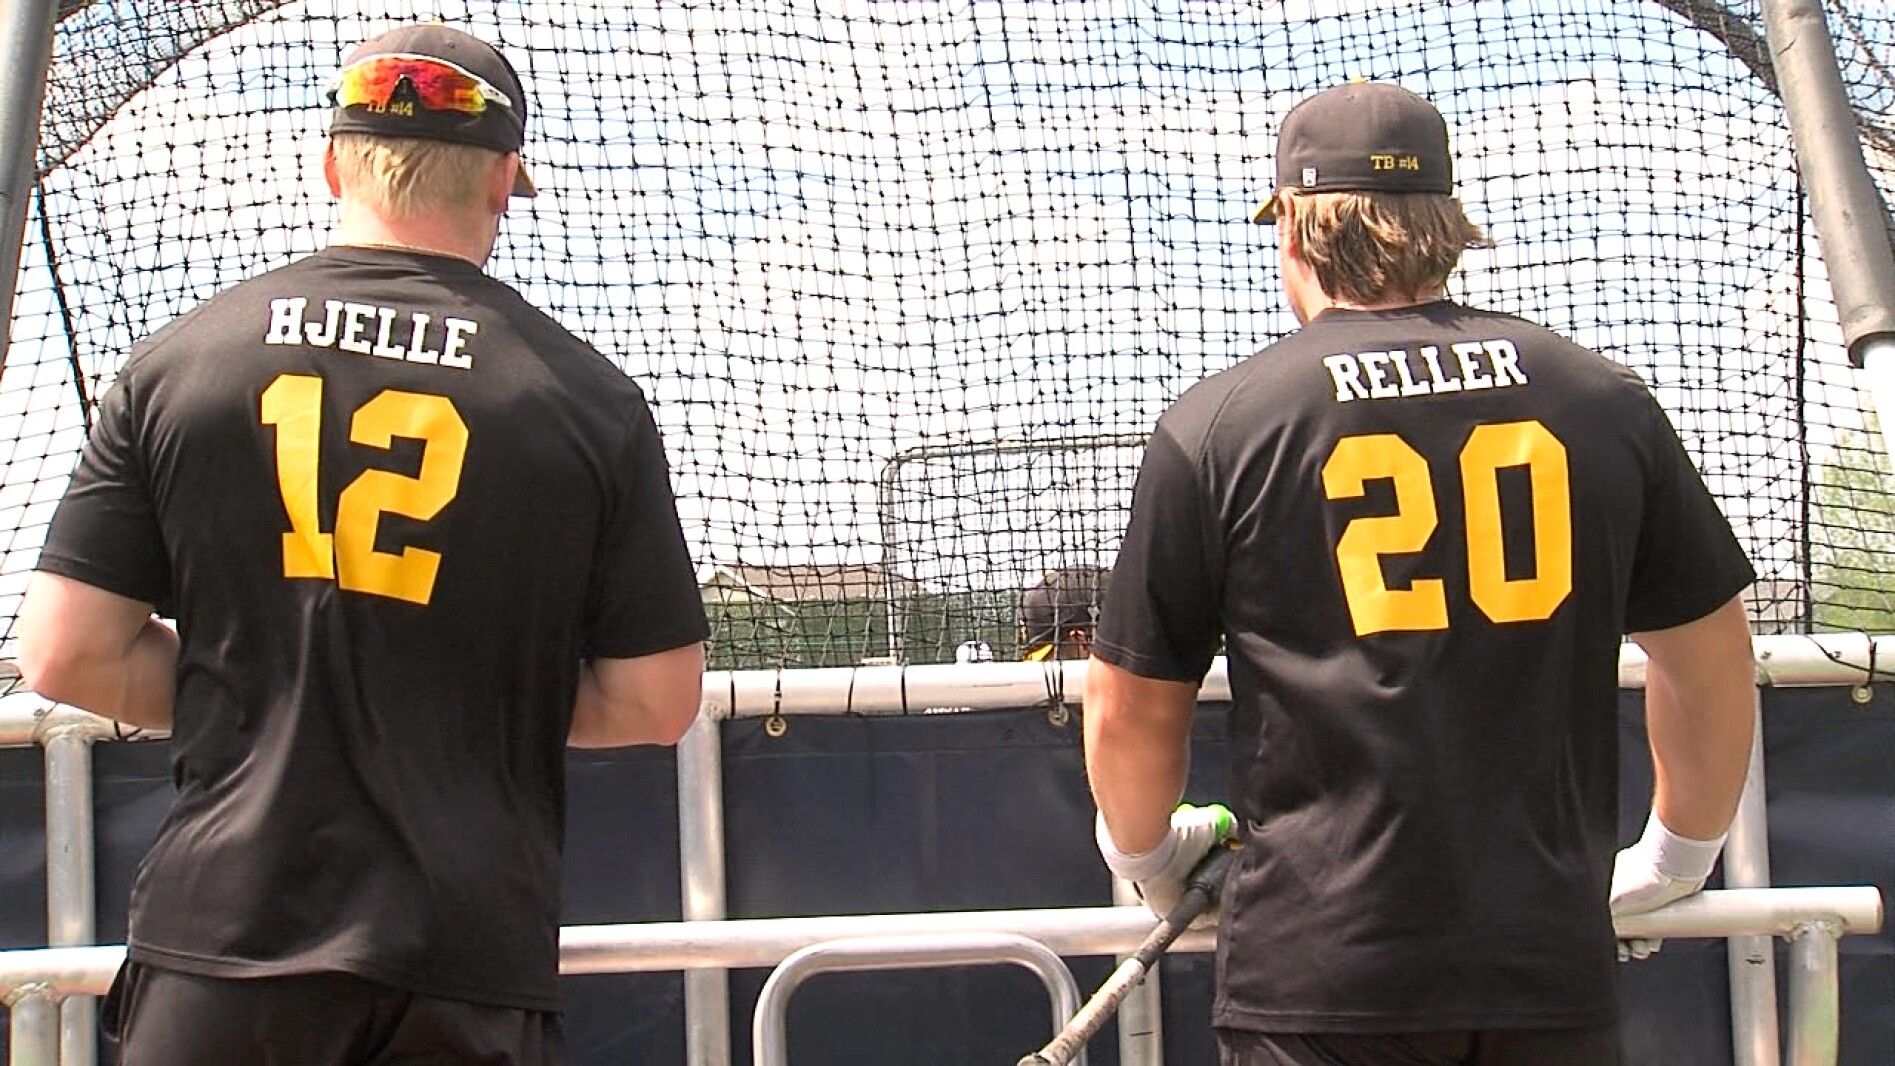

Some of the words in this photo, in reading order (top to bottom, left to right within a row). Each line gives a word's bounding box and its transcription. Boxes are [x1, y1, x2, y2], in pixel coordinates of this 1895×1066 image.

[390, 101, 414, 117] #14
[1370, 154, 1395, 170] TB
[1399, 155, 1420, 171] #14
[264, 297, 478, 370] HJELLE
[1322, 338, 1529, 403] RELLER
[261, 373, 470, 606] 12
[1321, 419, 1573, 637] 20
